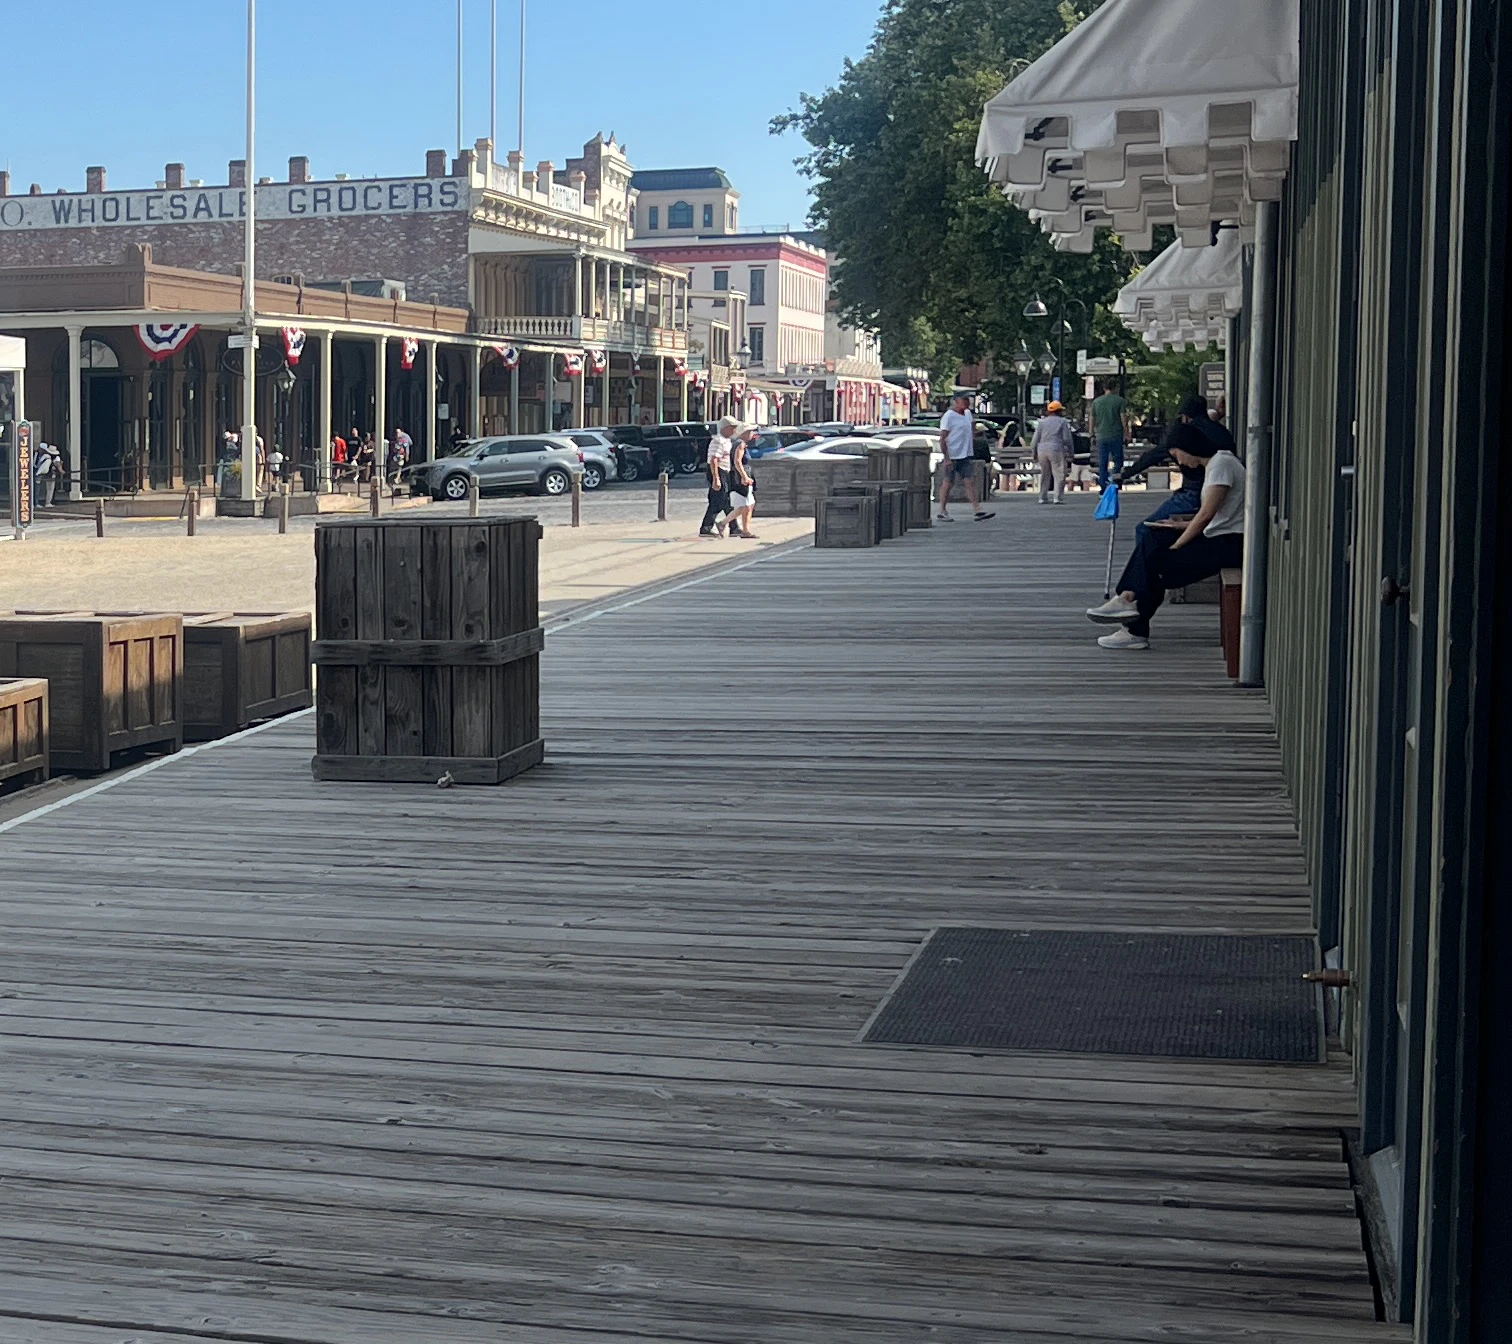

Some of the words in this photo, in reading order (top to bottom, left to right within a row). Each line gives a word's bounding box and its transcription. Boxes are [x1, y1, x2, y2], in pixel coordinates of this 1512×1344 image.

[51, 190, 257, 225] WHOLESALE
[288, 181, 459, 214] GROCERS
[18, 436, 30, 522] JEWELERS
